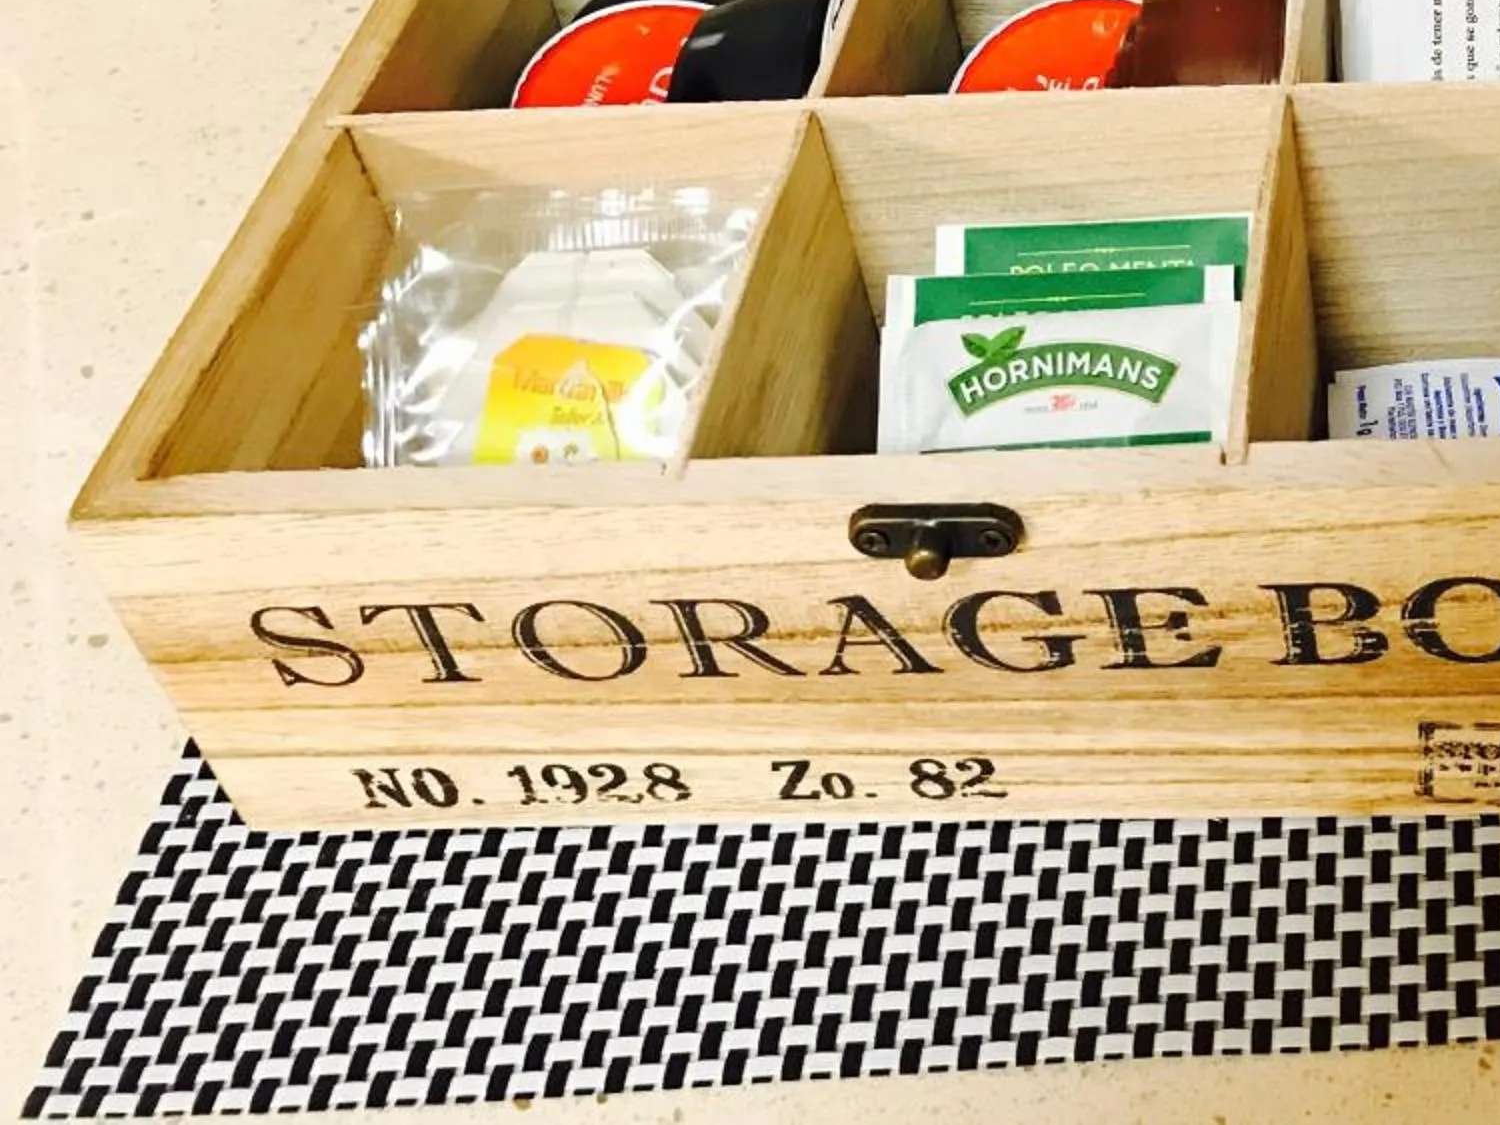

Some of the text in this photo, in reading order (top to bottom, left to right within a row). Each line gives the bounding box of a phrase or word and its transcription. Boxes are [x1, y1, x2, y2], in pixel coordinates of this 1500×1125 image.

[1431, 9, 1443, 45] tener
[1465, 45, 1479, 71] que
[960, 350, 1163, 406] HORNIMANS
[250, 585, 1222, 688] STORAGE
[351, 767, 487, 809] NO.
[507, 762, 692, 807] 1928
[909, 757, 1009, 801] 82
